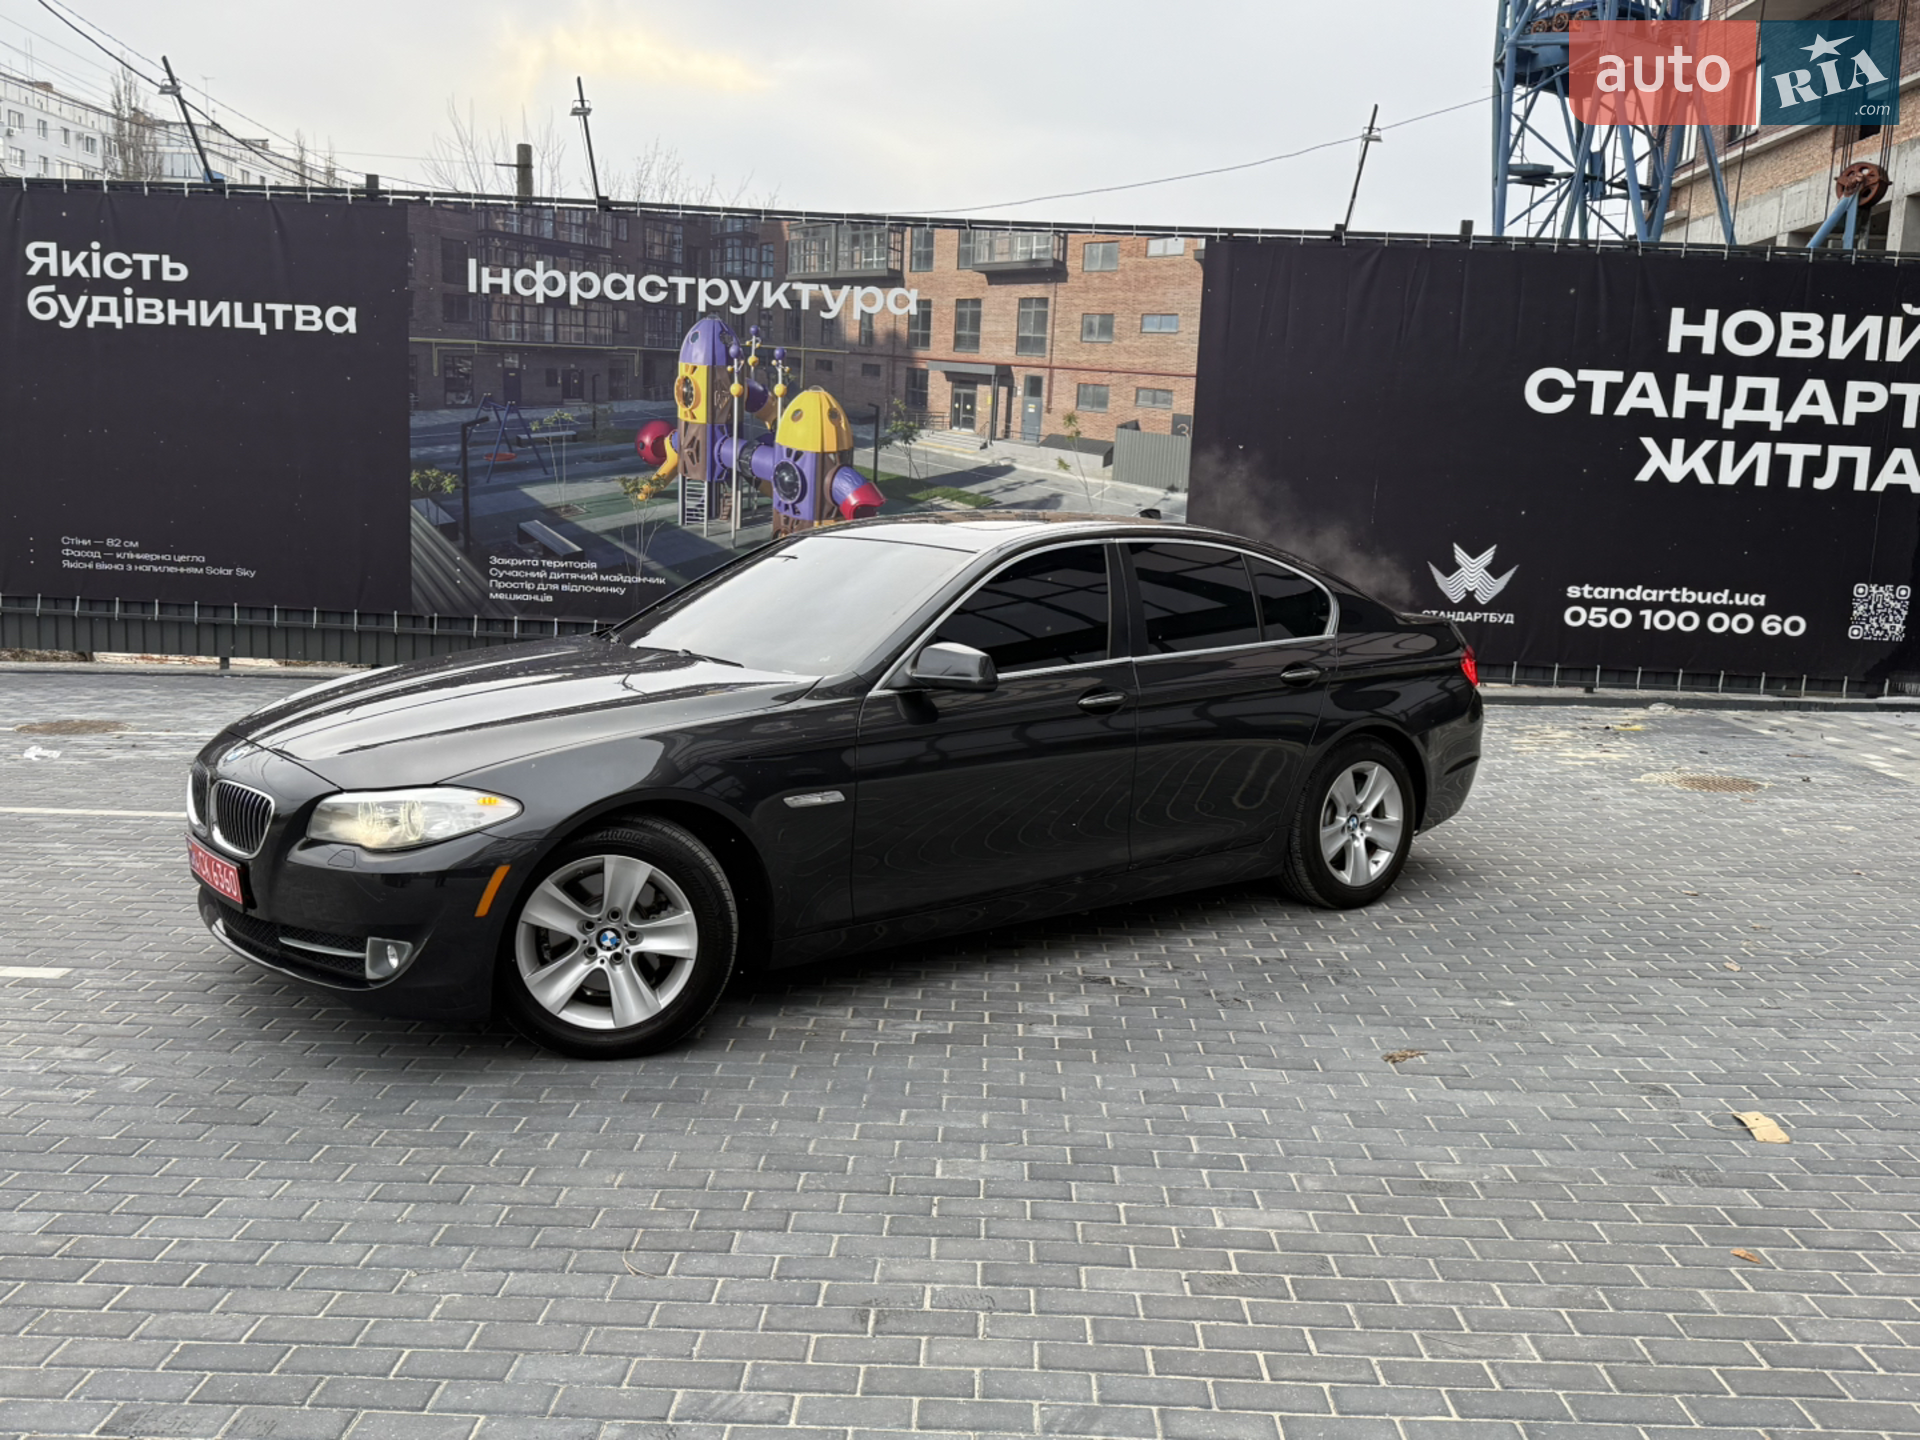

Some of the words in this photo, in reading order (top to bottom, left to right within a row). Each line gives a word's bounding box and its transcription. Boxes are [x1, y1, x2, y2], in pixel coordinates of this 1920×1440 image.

[25, 241, 189, 282] Якість
[467, 258, 919, 320] Інфраструктура
[27, 285, 357, 335] будівництва
[1667, 303, 1920, 362] НОВИЙ
[1524, 367, 1920, 431] СТАНДАРТ
[1634, 436, 1920, 493] ЖИТЛА
[61, 536, 91, 546] Стіни
[106, 538, 122, 548] 82
[61, 548, 102, 559] Фасад
[116, 551, 171, 562] клінкерна
[173, 554, 206, 564] цегла
[489, 555, 539, 567] Закрита
[540, 558, 597, 570] територія
[62, 560, 94, 569] Якісні
[95, 562, 125, 571] вікна
[126, 563, 133, 571] з
[134, 565, 204, 575] напиленням
[205, 566, 233, 576] Solar
[235, 568, 257, 578] Sky
[489, 568, 548, 579] Сучасний
[549, 571, 598, 582] дитячий
[600, 572, 666, 585] майданчик
[489, 579, 535, 590] Простір
[536, 582, 559, 591] для
[561, 582, 626, 596] відпочинку
[489, 592, 553, 602] мешканців
[1566, 583, 1766, 607] standartbud.ua
[1563, 606, 1633, 629] 050
[1639, 608, 1701, 632] 100
[1706, 612, 1755, 635] 00
[1760, 614, 1808, 637] 60
